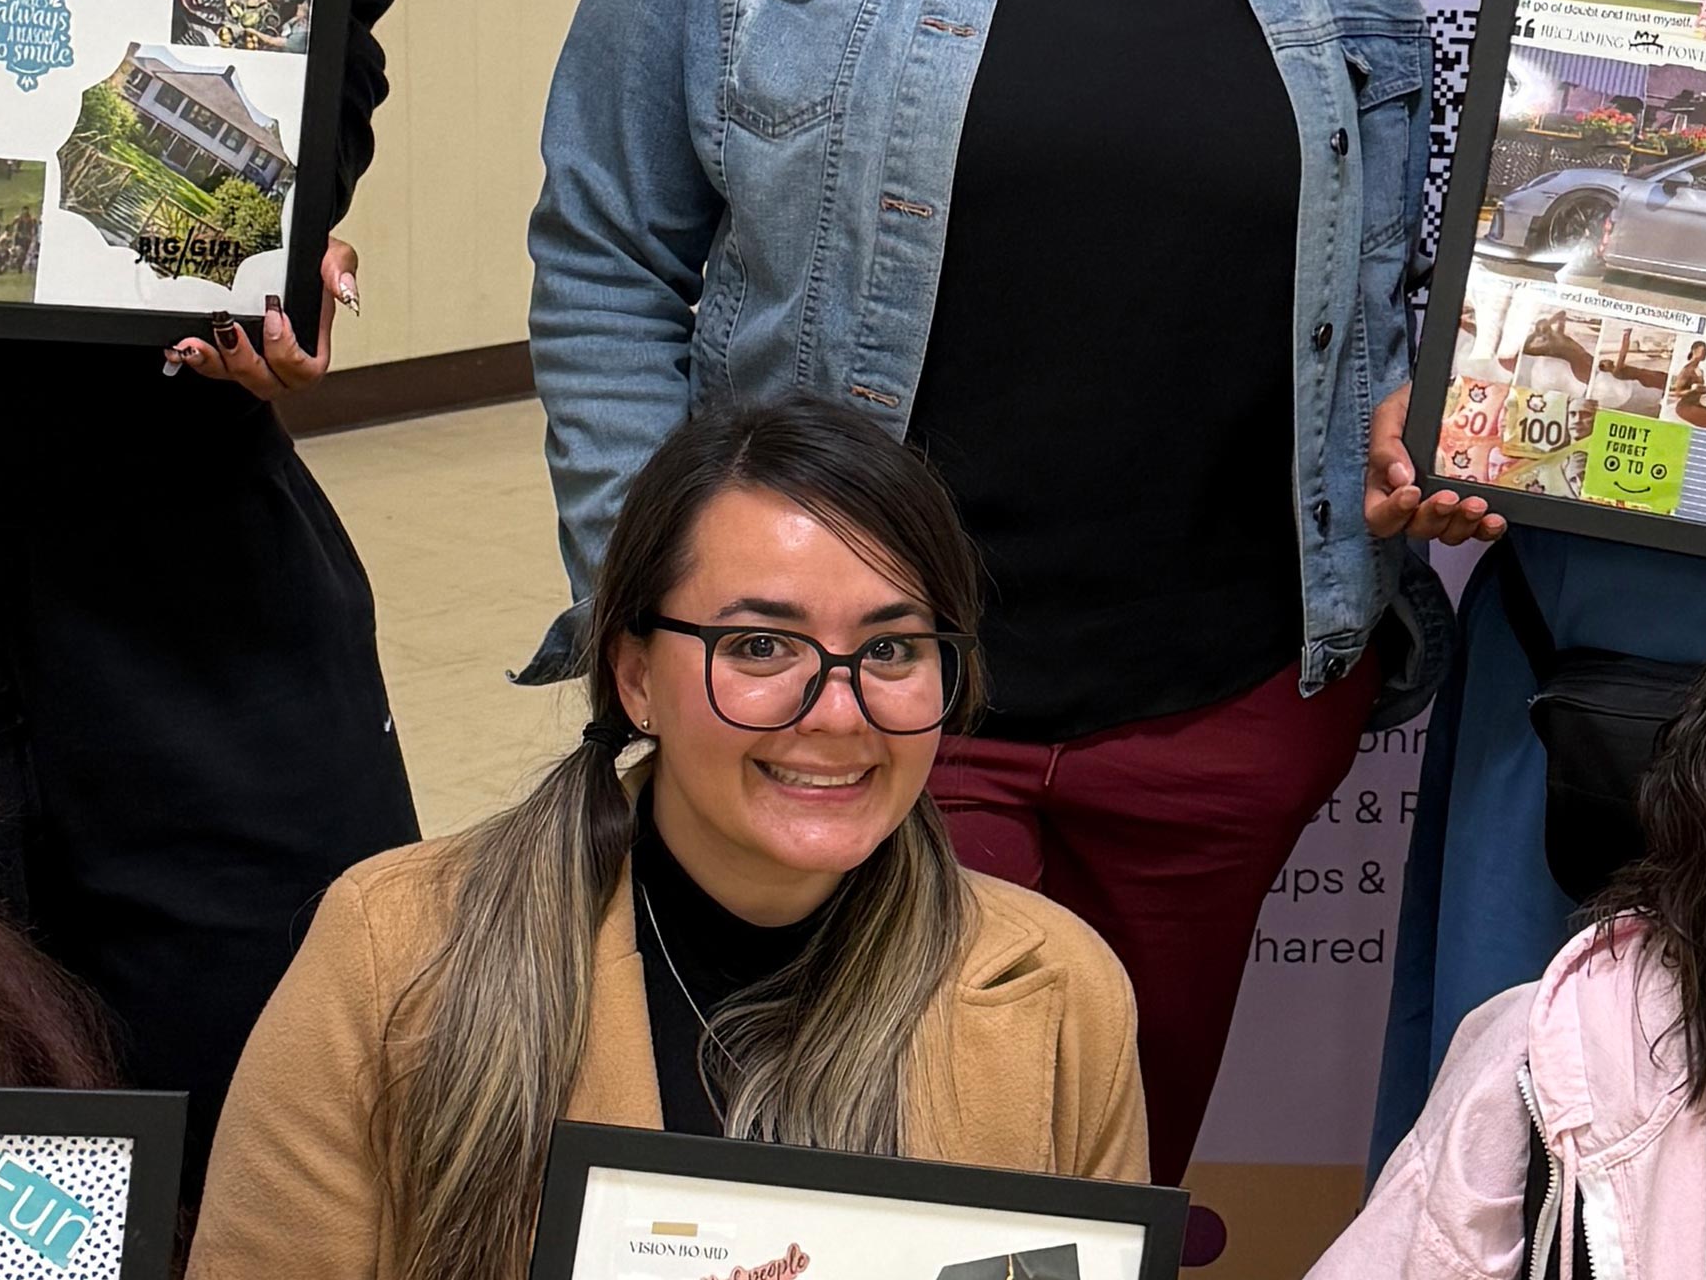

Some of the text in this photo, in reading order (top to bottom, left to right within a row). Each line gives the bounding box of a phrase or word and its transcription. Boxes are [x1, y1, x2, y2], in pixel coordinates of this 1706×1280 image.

[1541, 24, 1624, 49] RECLAIMING
[14, 41, 71, 64] smile
[1518, 417, 1562, 446] 100
[1609, 423, 1651, 441] DON'T
[1606, 440, 1648, 457] FORGET
[1627, 459, 1644, 475] TO
[1356, 790, 1383, 824] &
[1359, 861, 1385, 894] &
[1254, 929, 1385, 963] hared
[629, 1241, 729, 1261] VISION BOARD
